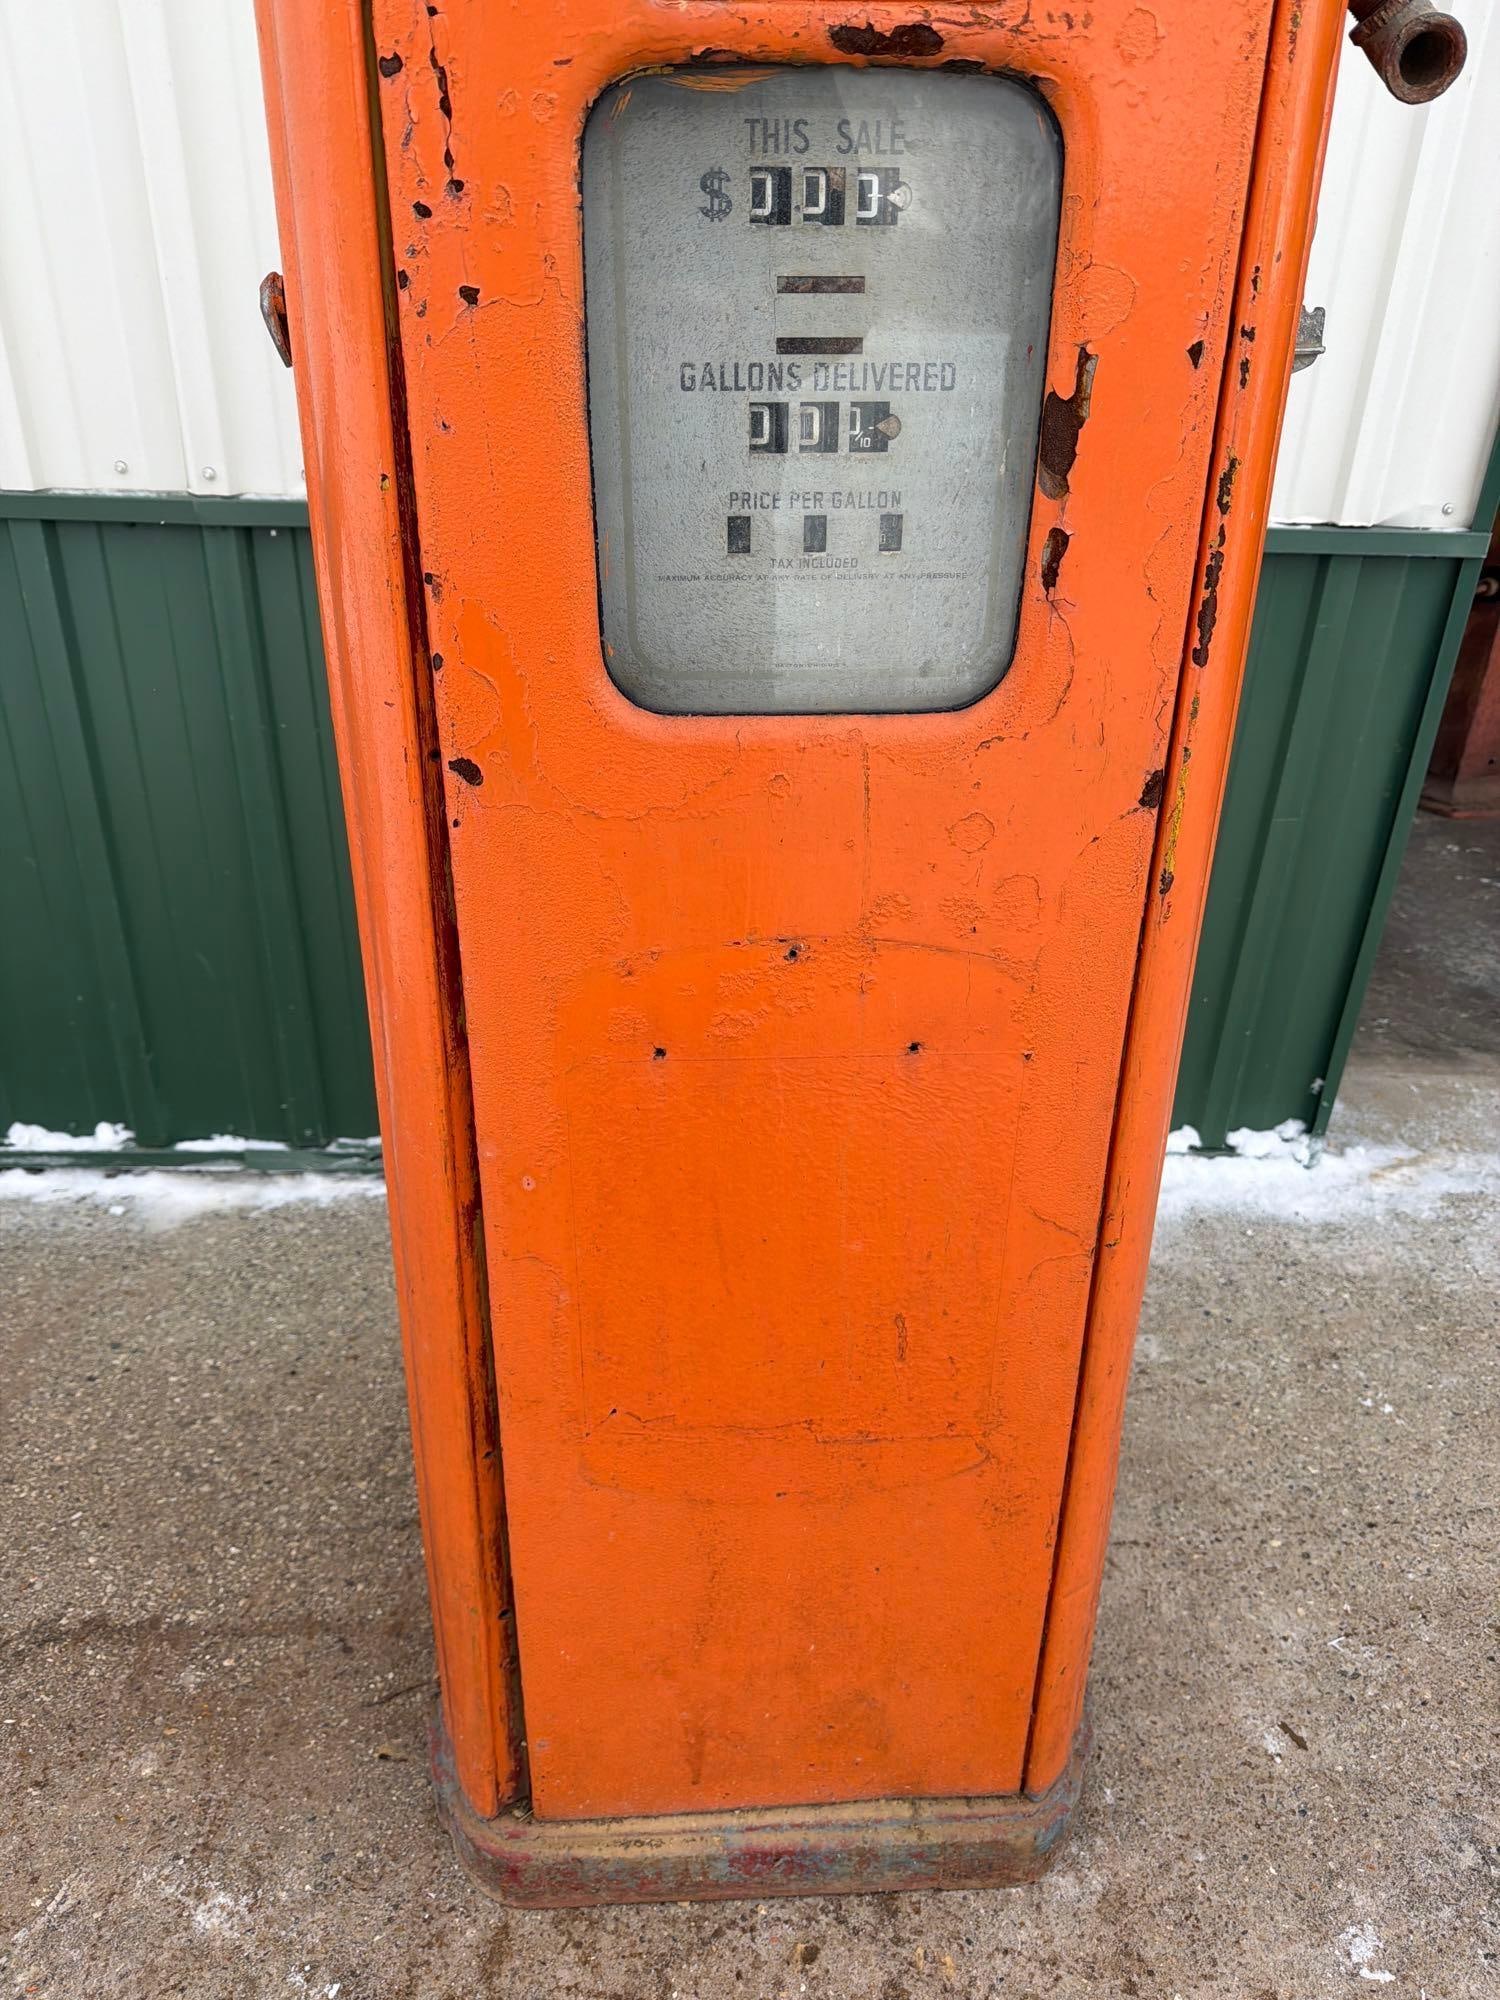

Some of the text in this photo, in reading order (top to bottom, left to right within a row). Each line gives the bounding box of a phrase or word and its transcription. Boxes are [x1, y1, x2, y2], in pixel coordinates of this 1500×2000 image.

[744, 118, 905, 155] THIS SALE
[699, 166, 733, 222] $
[680, 362, 957, 392] GALLONS DELIVERED
[729, 490, 901, 510] PRICE PER GALLON
[770, 557, 858, 569] TAX INCLUDED
[705, 574, 752, 582] ACCURACY
[883, 572, 895, 580] AT
[920, 571, 968, 579] PRESSURE
